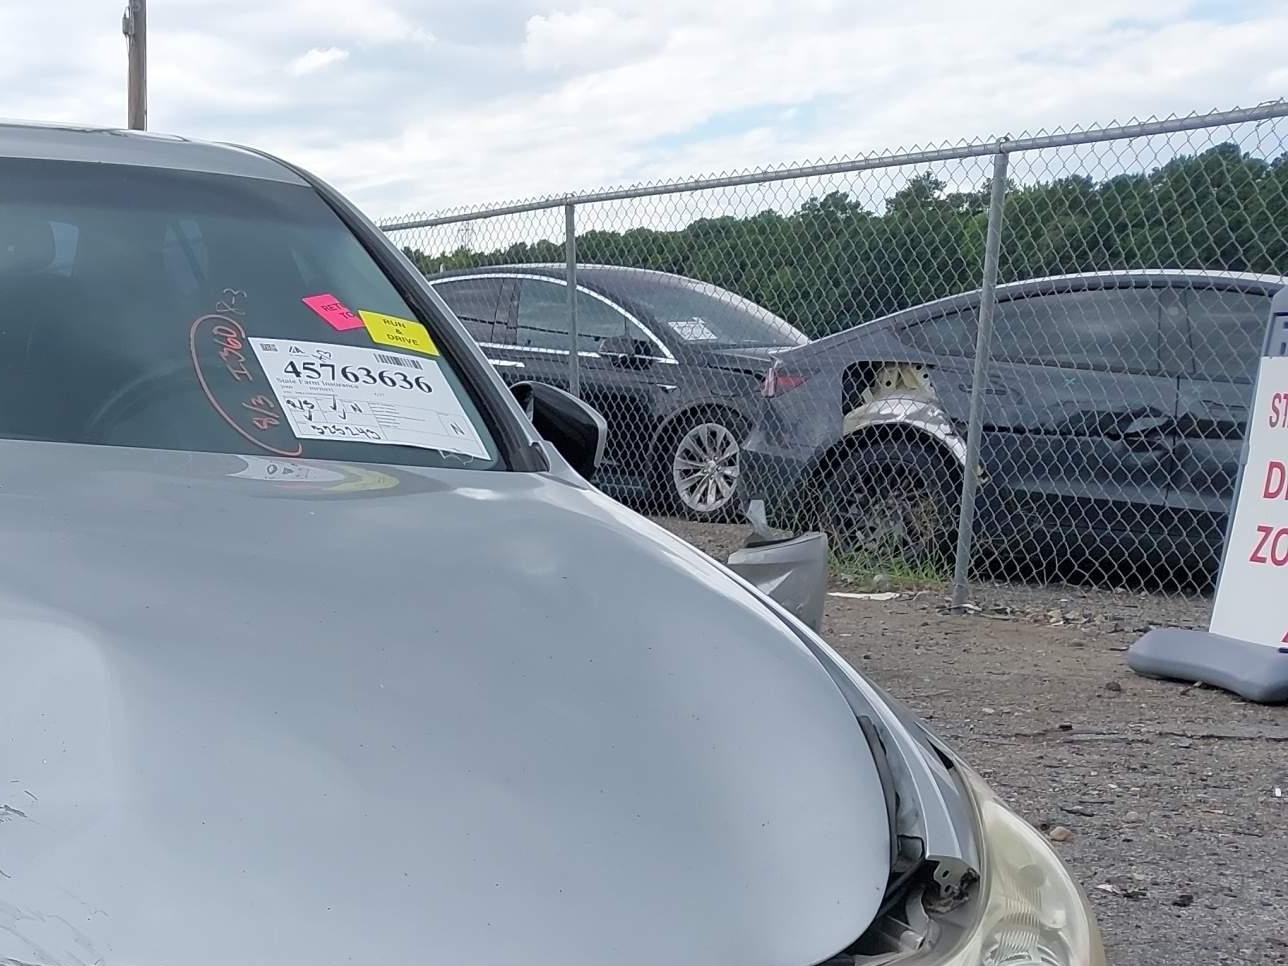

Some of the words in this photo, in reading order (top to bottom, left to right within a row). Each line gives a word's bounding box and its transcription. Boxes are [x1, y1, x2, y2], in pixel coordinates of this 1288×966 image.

[382, 318, 406, 329] RUN
[387, 333, 420, 345] DRIVE
[284, 360, 433, 394] 45763636
[1269, 392, 1288, 428] ST
[1263, 461, 1288, 500] D
[1249, 525, 1288, 566] ZO
